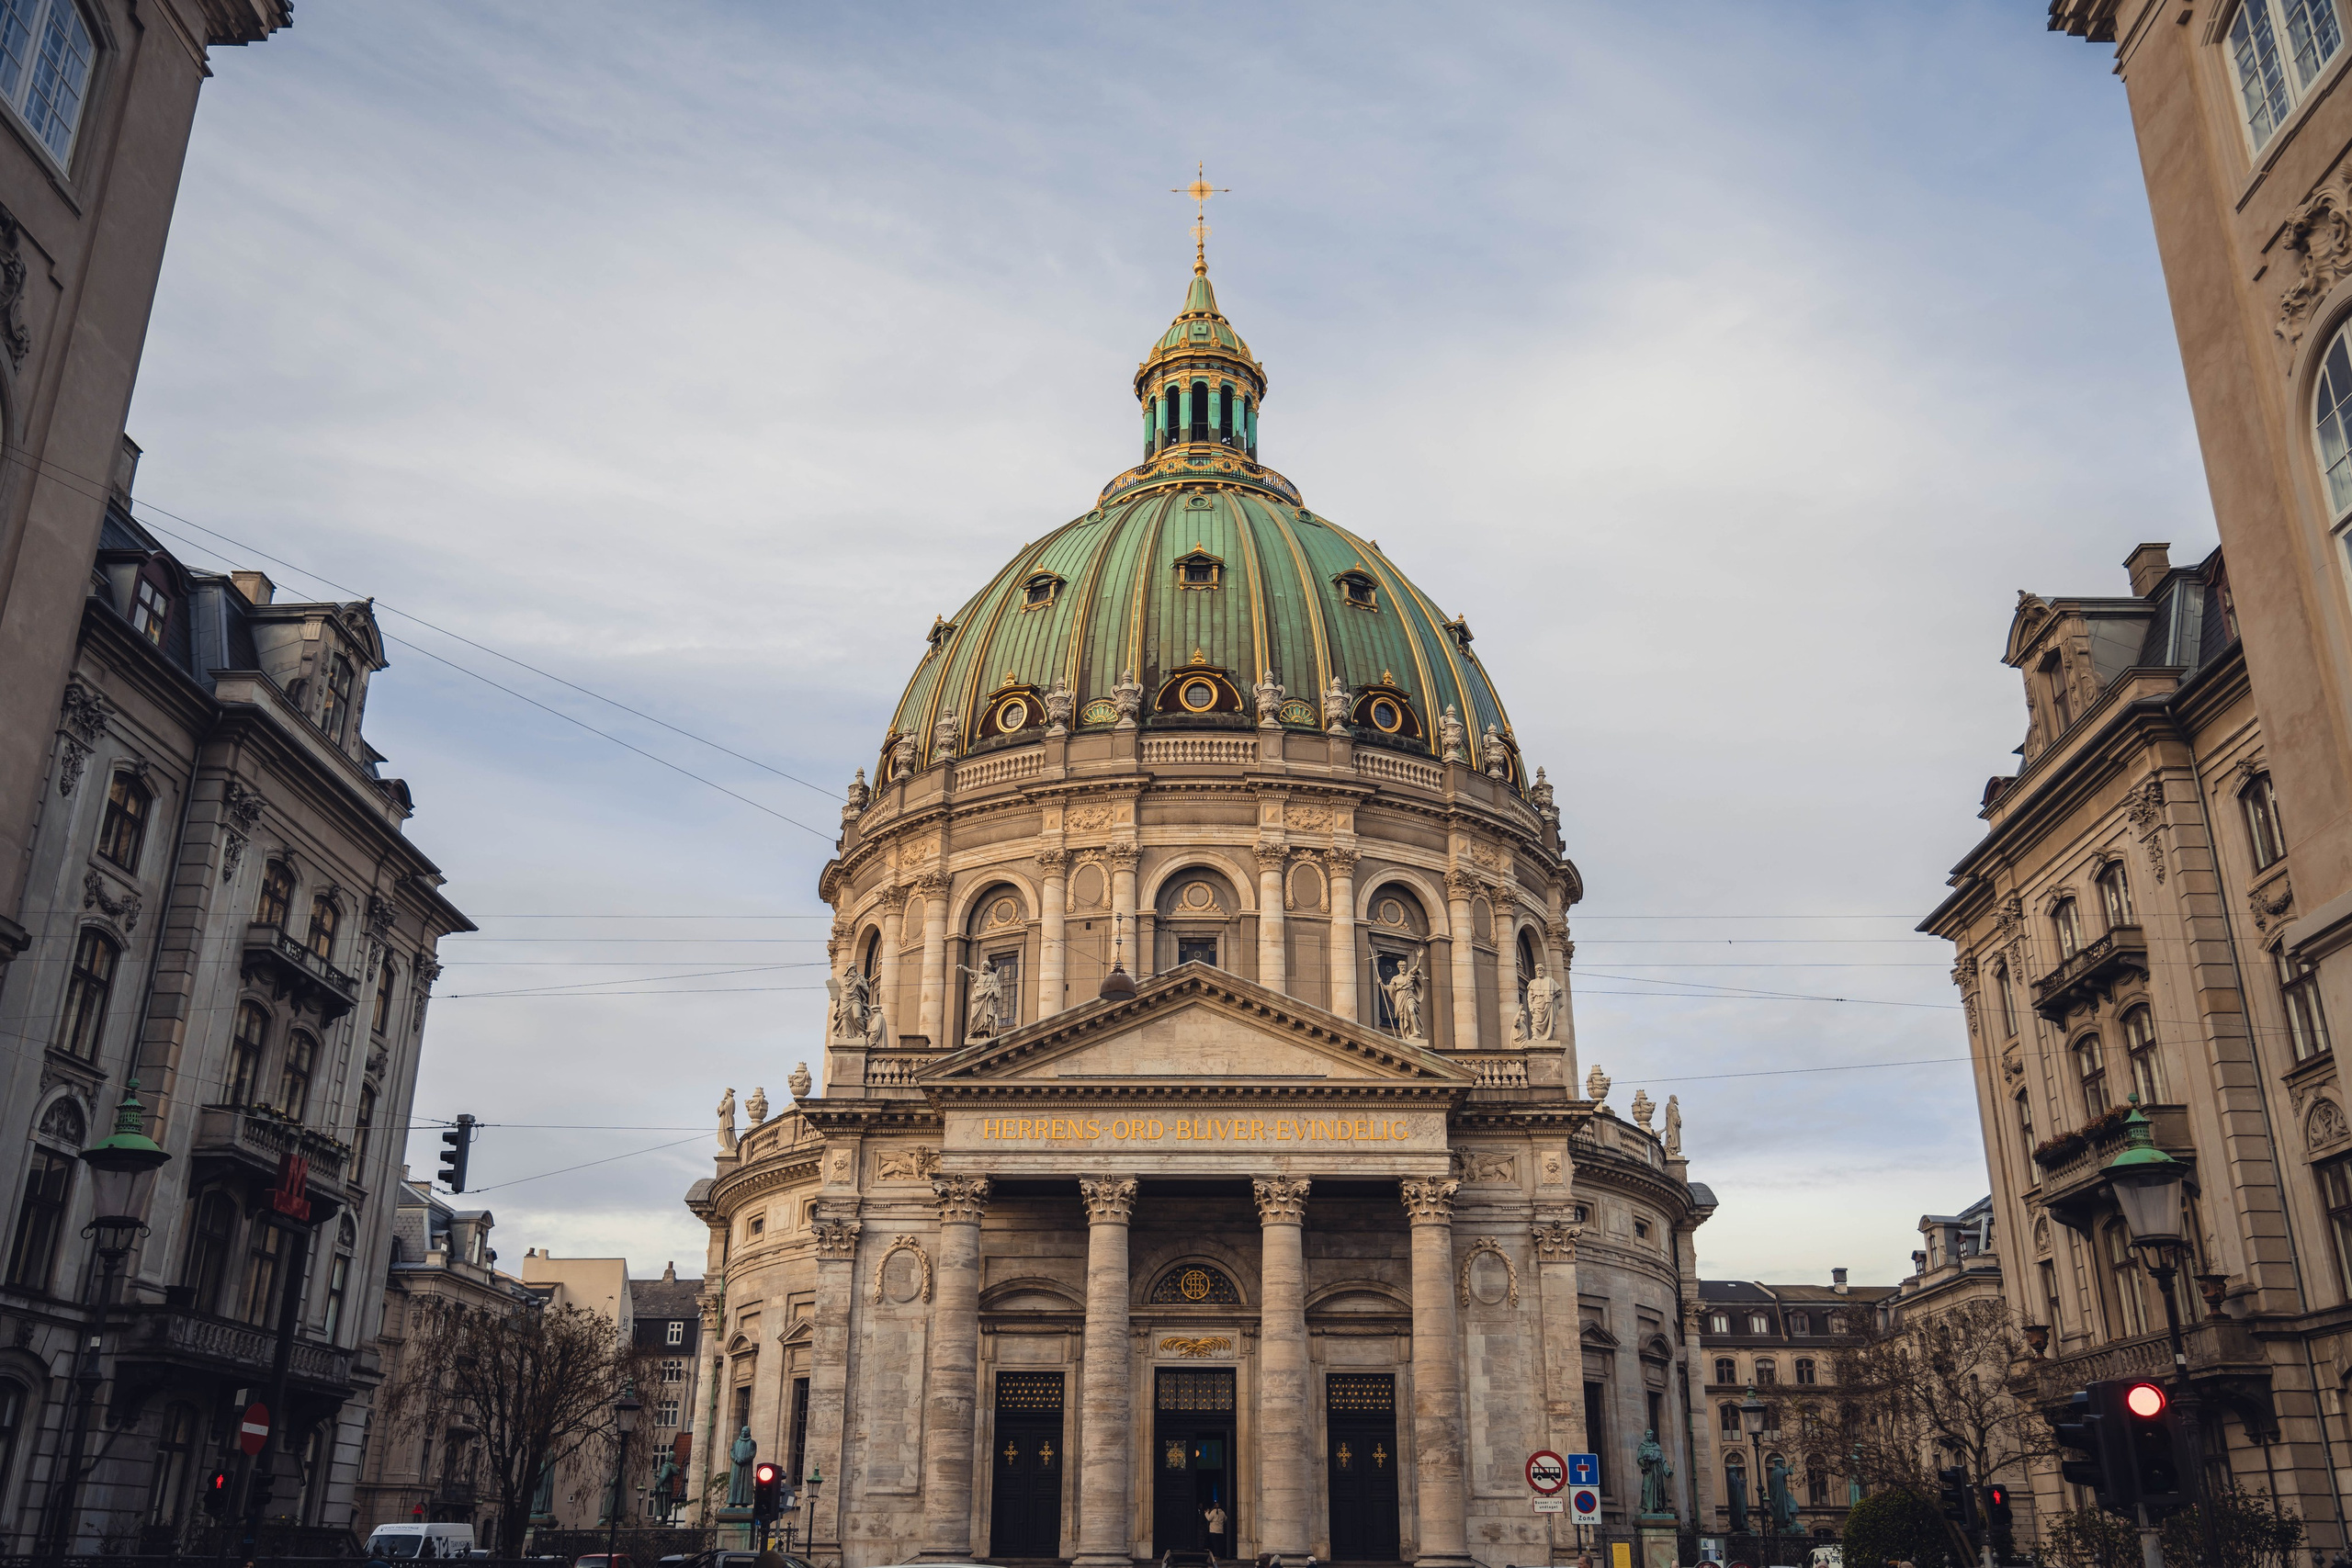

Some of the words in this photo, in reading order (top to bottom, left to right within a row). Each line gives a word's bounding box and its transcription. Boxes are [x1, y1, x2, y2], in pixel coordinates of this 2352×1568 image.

[983, 1119, 1101, 1140] HERRENS
[1112, 1120, 1165, 1140] ORD
[1176, 1120, 1266, 1140] BLIVER
[1276, 1120, 1408, 1140] EVINDELIG
